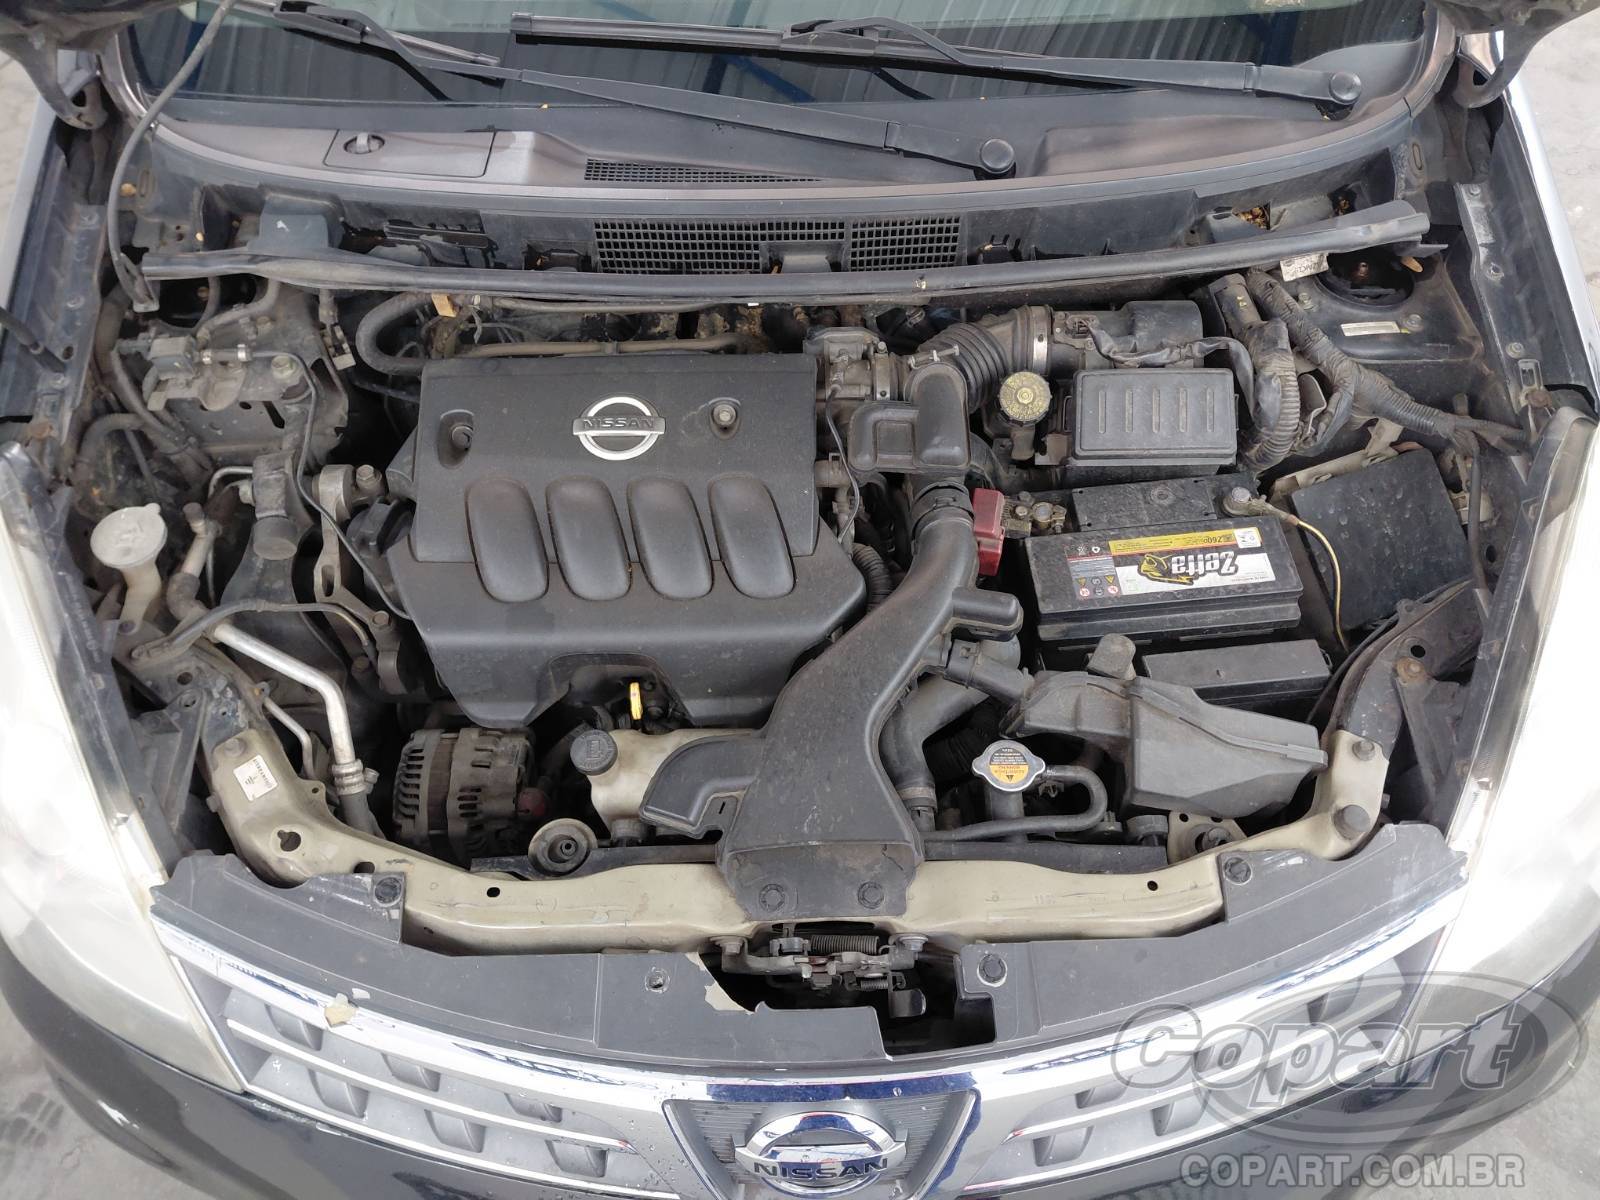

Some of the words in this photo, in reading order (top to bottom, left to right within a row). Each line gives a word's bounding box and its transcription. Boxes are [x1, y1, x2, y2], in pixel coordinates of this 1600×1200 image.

[582, 417, 654, 430] NISSAN
[1170, 551, 1237, 577] Zetta
[753, 1157, 888, 1179] NISSAN
